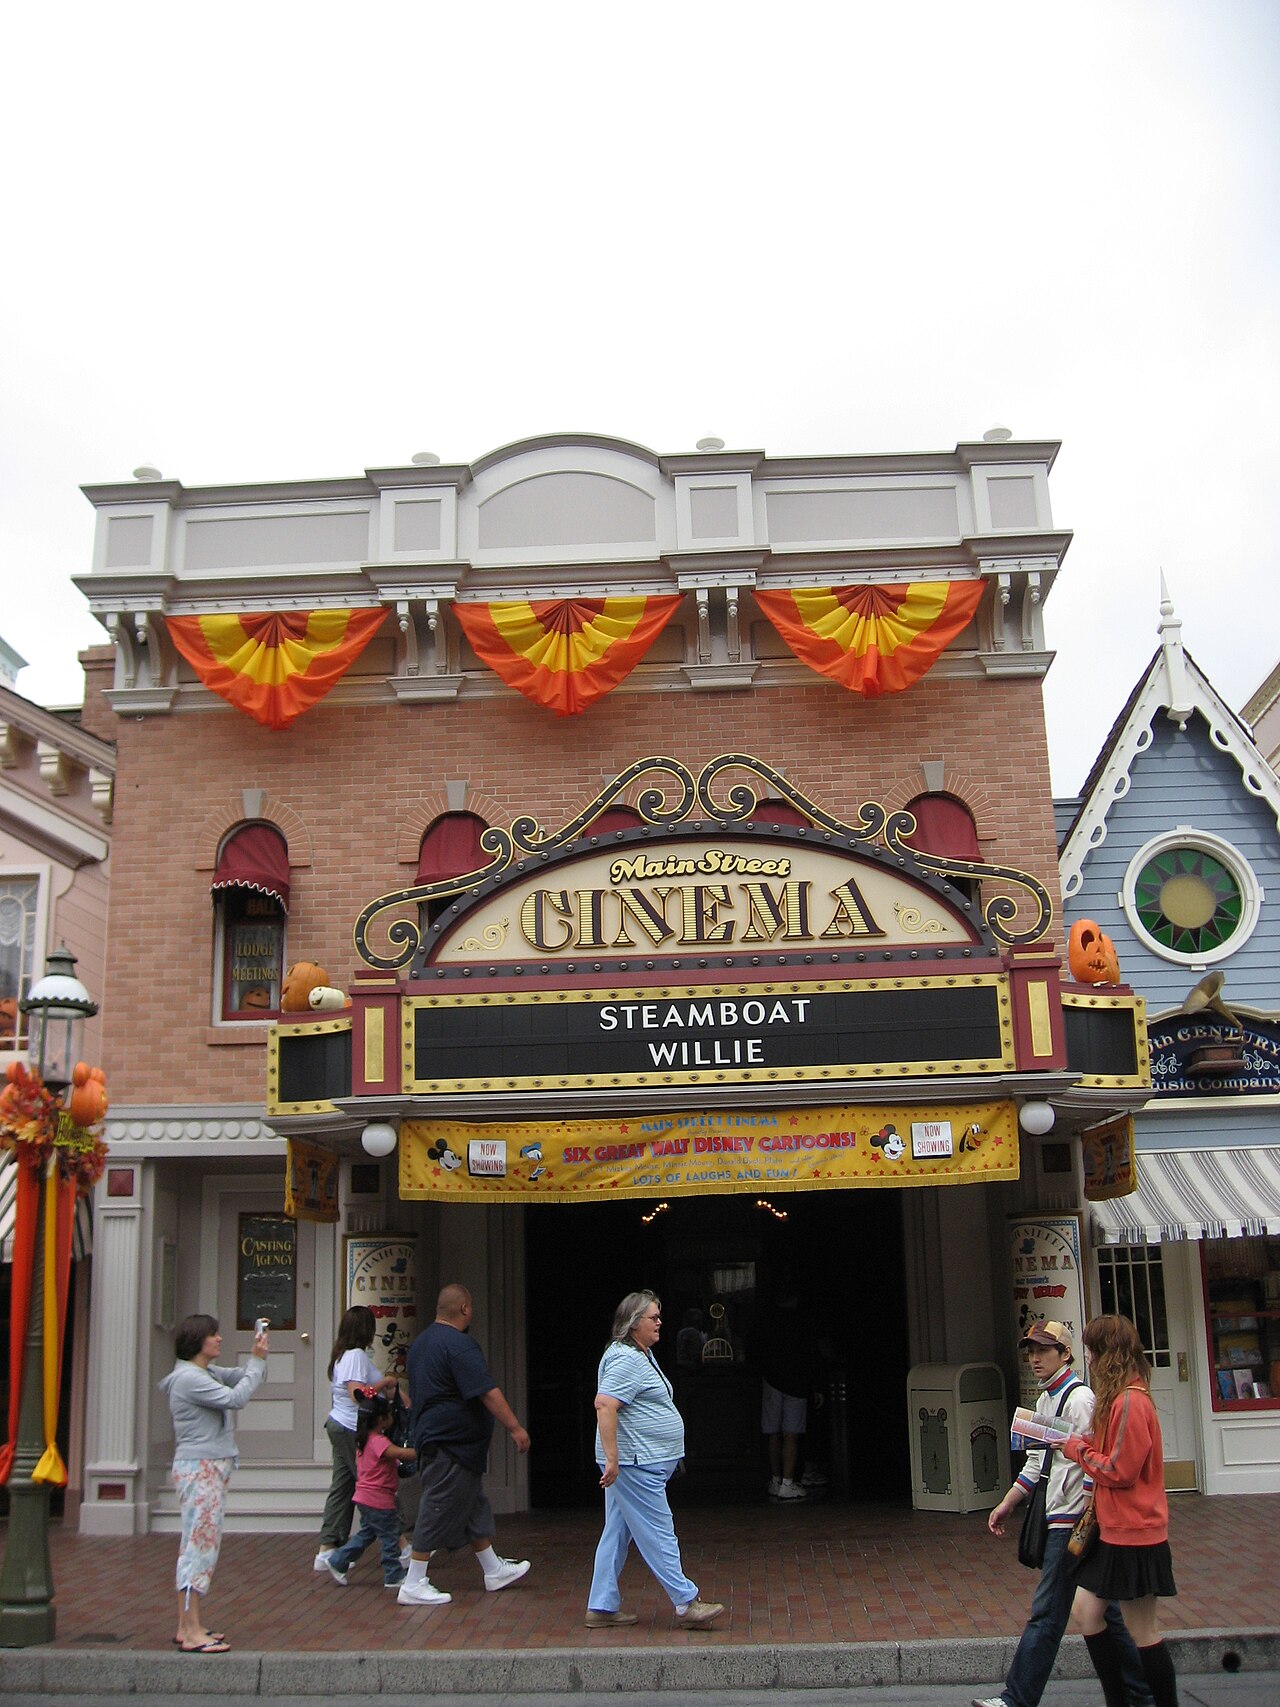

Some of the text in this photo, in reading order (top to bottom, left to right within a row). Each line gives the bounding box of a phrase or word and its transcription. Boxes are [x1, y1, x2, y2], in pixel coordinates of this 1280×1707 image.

[610, 849, 791, 884] Main Street
[520, 877, 887, 952] CINEMA
[236, 943, 275, 958] LODGE
[231, 966, 279, 981] MEETINGS
[599, 999, 811, 1031] STEAMBOAT
[648, 1039, 765, 1067] WILLIE
[726, 1114, 779, 1127] CINEMA
[924, 1125, 941, 1137] NOW
[480, 1143, 497, 1156] NOW
[564, 1131, 856, 1163] SIX GREAT WALT DISNEY CARTOONS!
[917, 1141, 950, 1154] SHOWING
[472, 1159, 504, 1172] SHOWING
[633, 1174, 661, 1185] LOTS
[665, 1172, 681, 1183] OF
[686, 1169, 731, 1181] LAUGHS
[736, 1168, 761, 1179] AND
